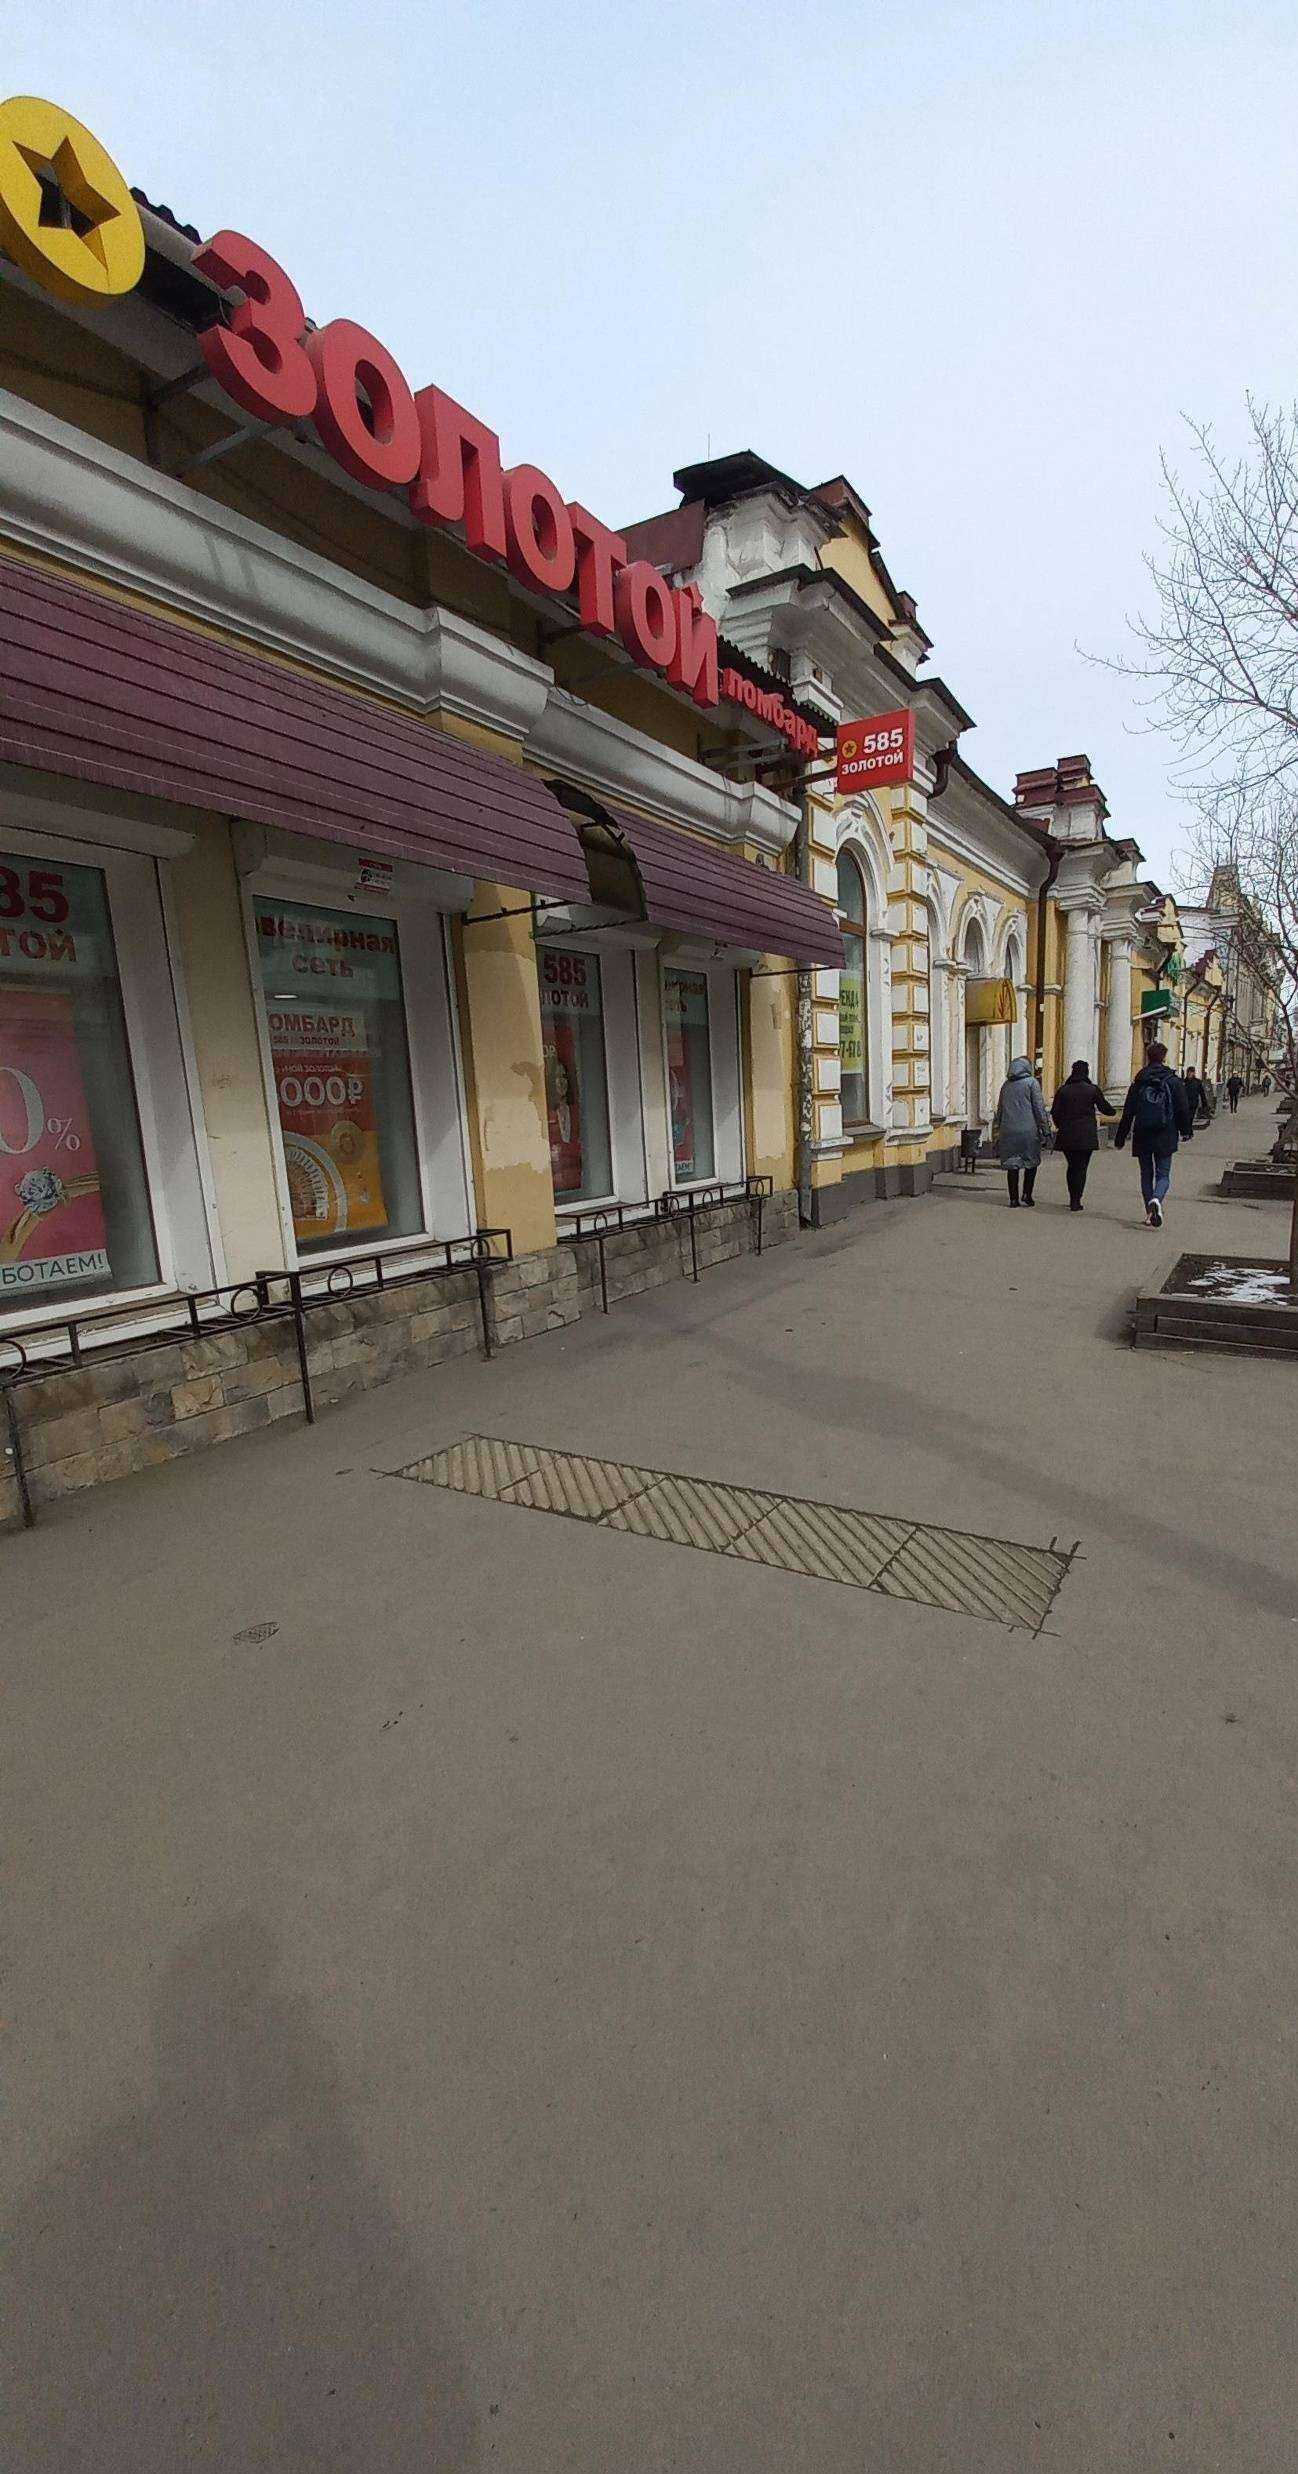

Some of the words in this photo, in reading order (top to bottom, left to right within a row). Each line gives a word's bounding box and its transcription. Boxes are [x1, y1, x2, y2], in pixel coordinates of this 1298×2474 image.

[190, 228, 719, 708] ЗОЛОТОЙ
[863, 728, 904, 754] 585
[841, 749, 904, 775] ЗОЛОТОЙ
[544, 953, 587, 986] 585
[2, 1252, 105, 1285] БОТАЕМ!
